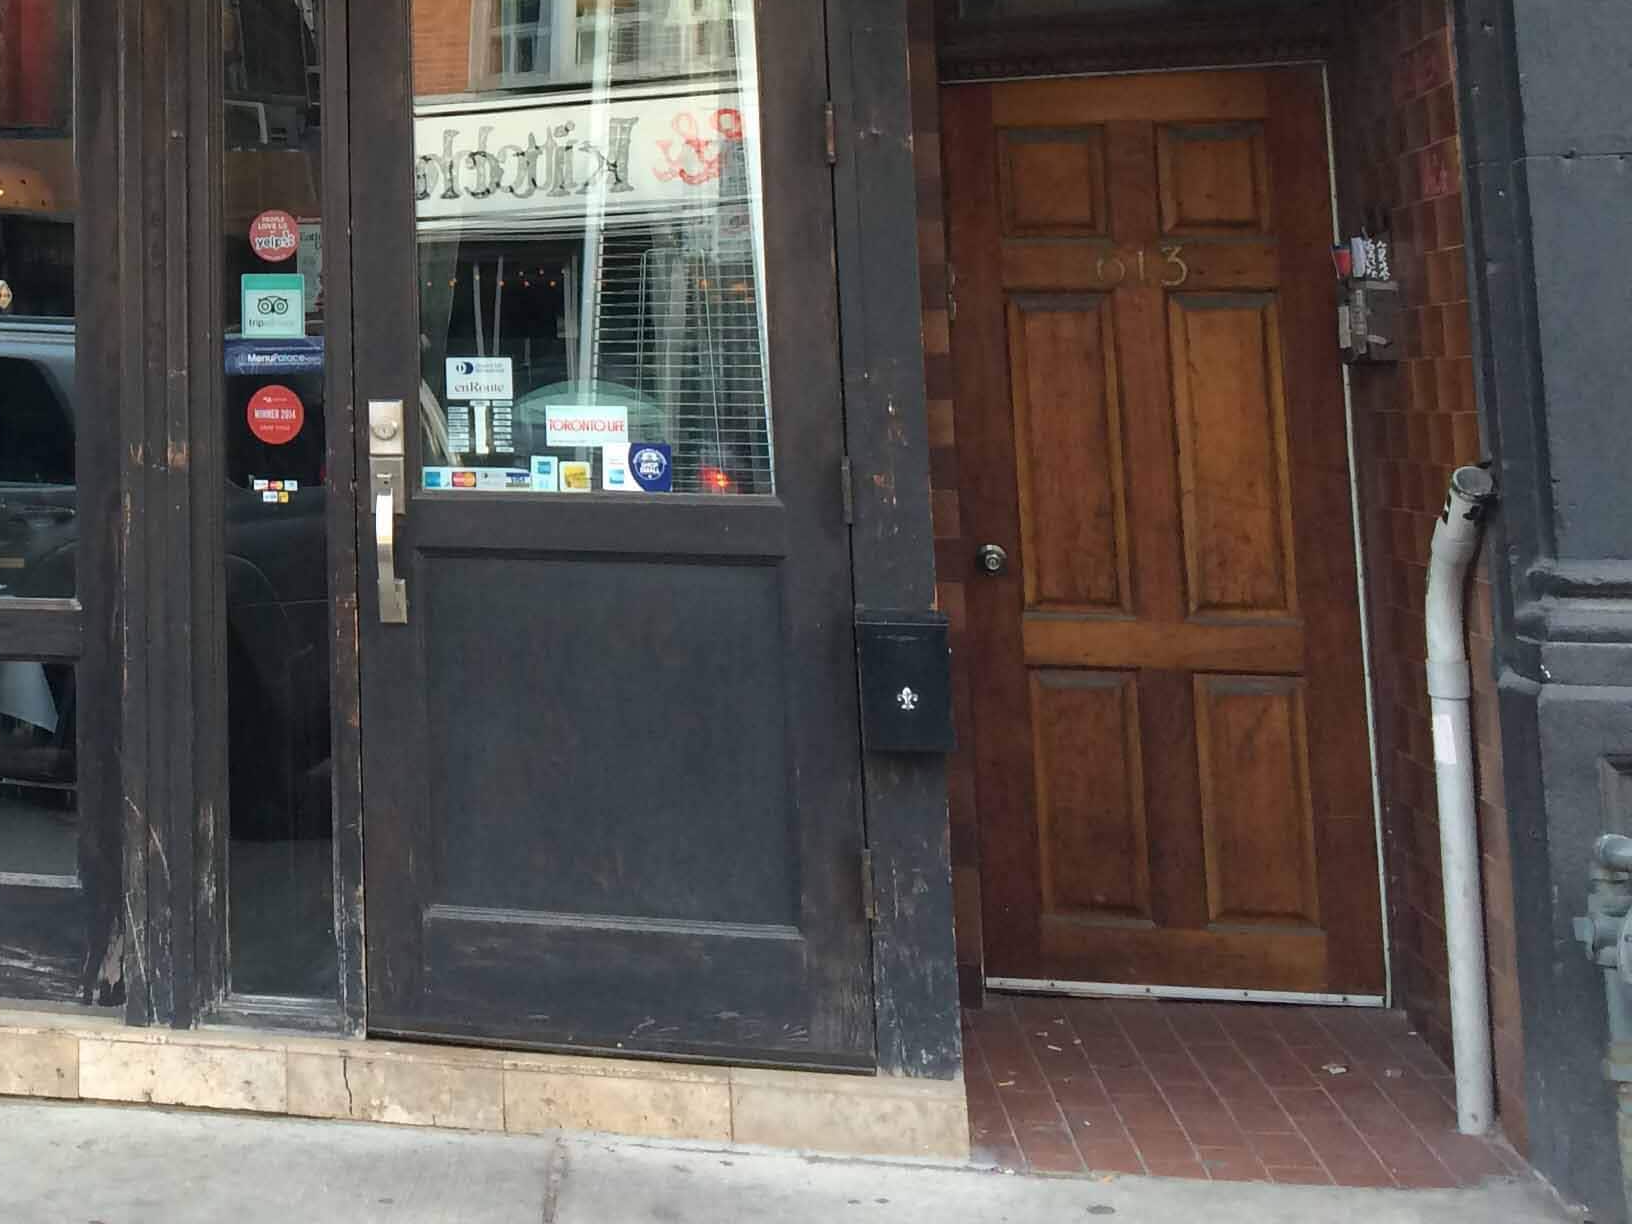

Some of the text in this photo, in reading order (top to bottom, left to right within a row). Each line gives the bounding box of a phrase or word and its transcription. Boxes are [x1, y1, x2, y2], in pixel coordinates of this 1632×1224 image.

[256, 235, 282, 250] yelp
[454, 381, 505, 393] enRoute
[549, 418, 625, 433] TORONTO LIFE
